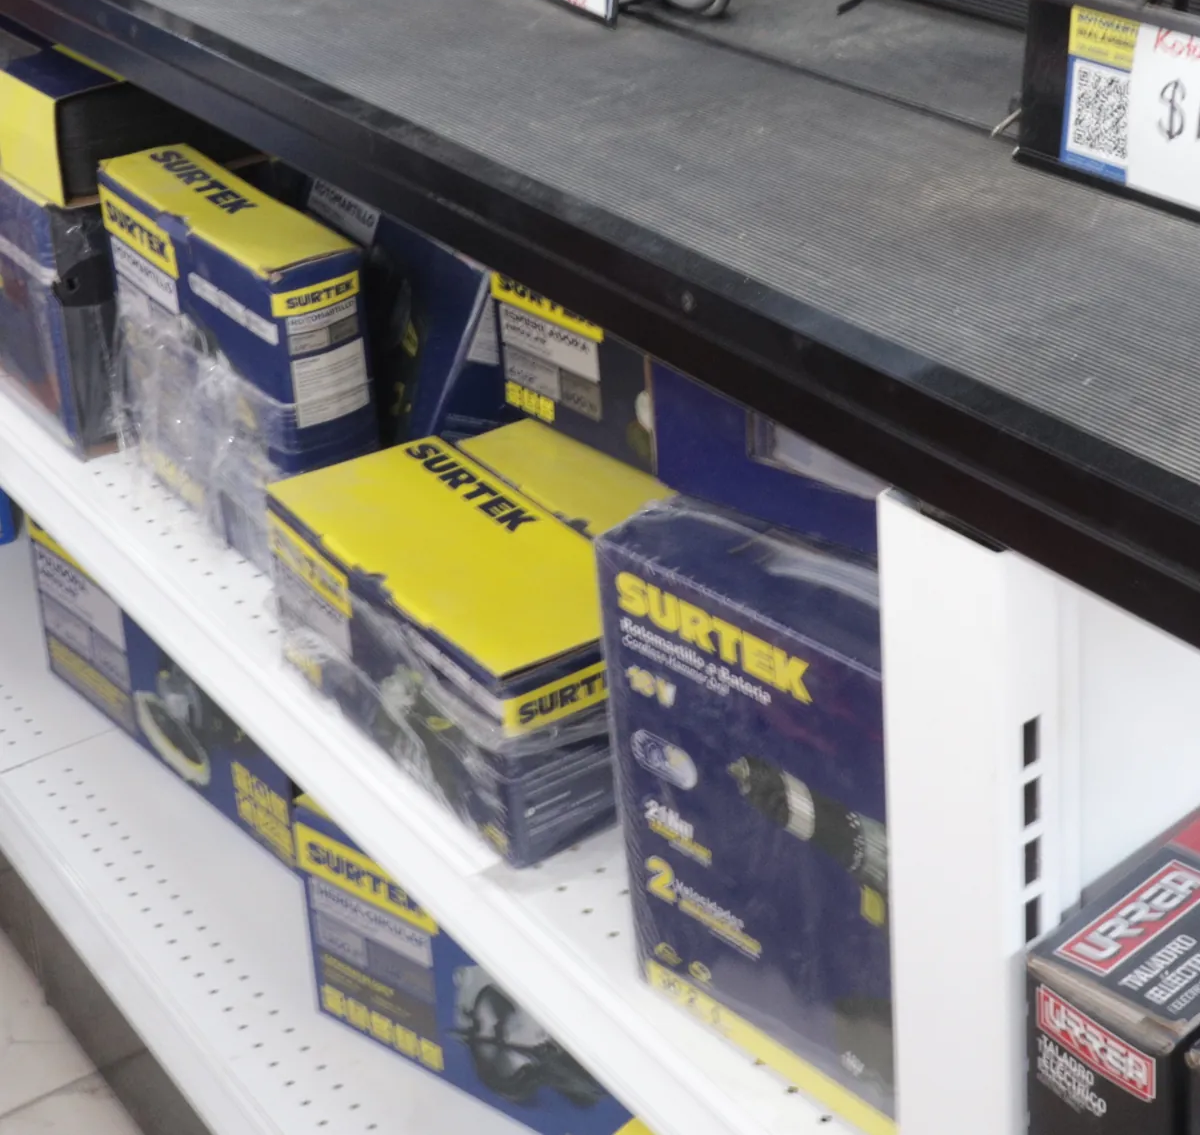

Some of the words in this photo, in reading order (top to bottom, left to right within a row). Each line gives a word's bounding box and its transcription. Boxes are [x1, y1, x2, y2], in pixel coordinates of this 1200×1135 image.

[150, 149, 259, 216] SURTEK
[105, 199, 170, 263] SURTEK
[285, 277, 356, 311] SURTEK
[404, 441, 541, 534] SURTEK
[615, 570, 813, 706] SURTEK
[619, 615, 706, 670] Rotomartillo
[517, 671, 609, 726] SURT
[305, 839, 431, 918] SURTE
[645, 853, 677, 906] 2
[1118, 933, 1199, 993] TALADRO
[1036, 1034, 1095, 1088] TALADRO
[1044, 992, 1150, 1091] URREA
